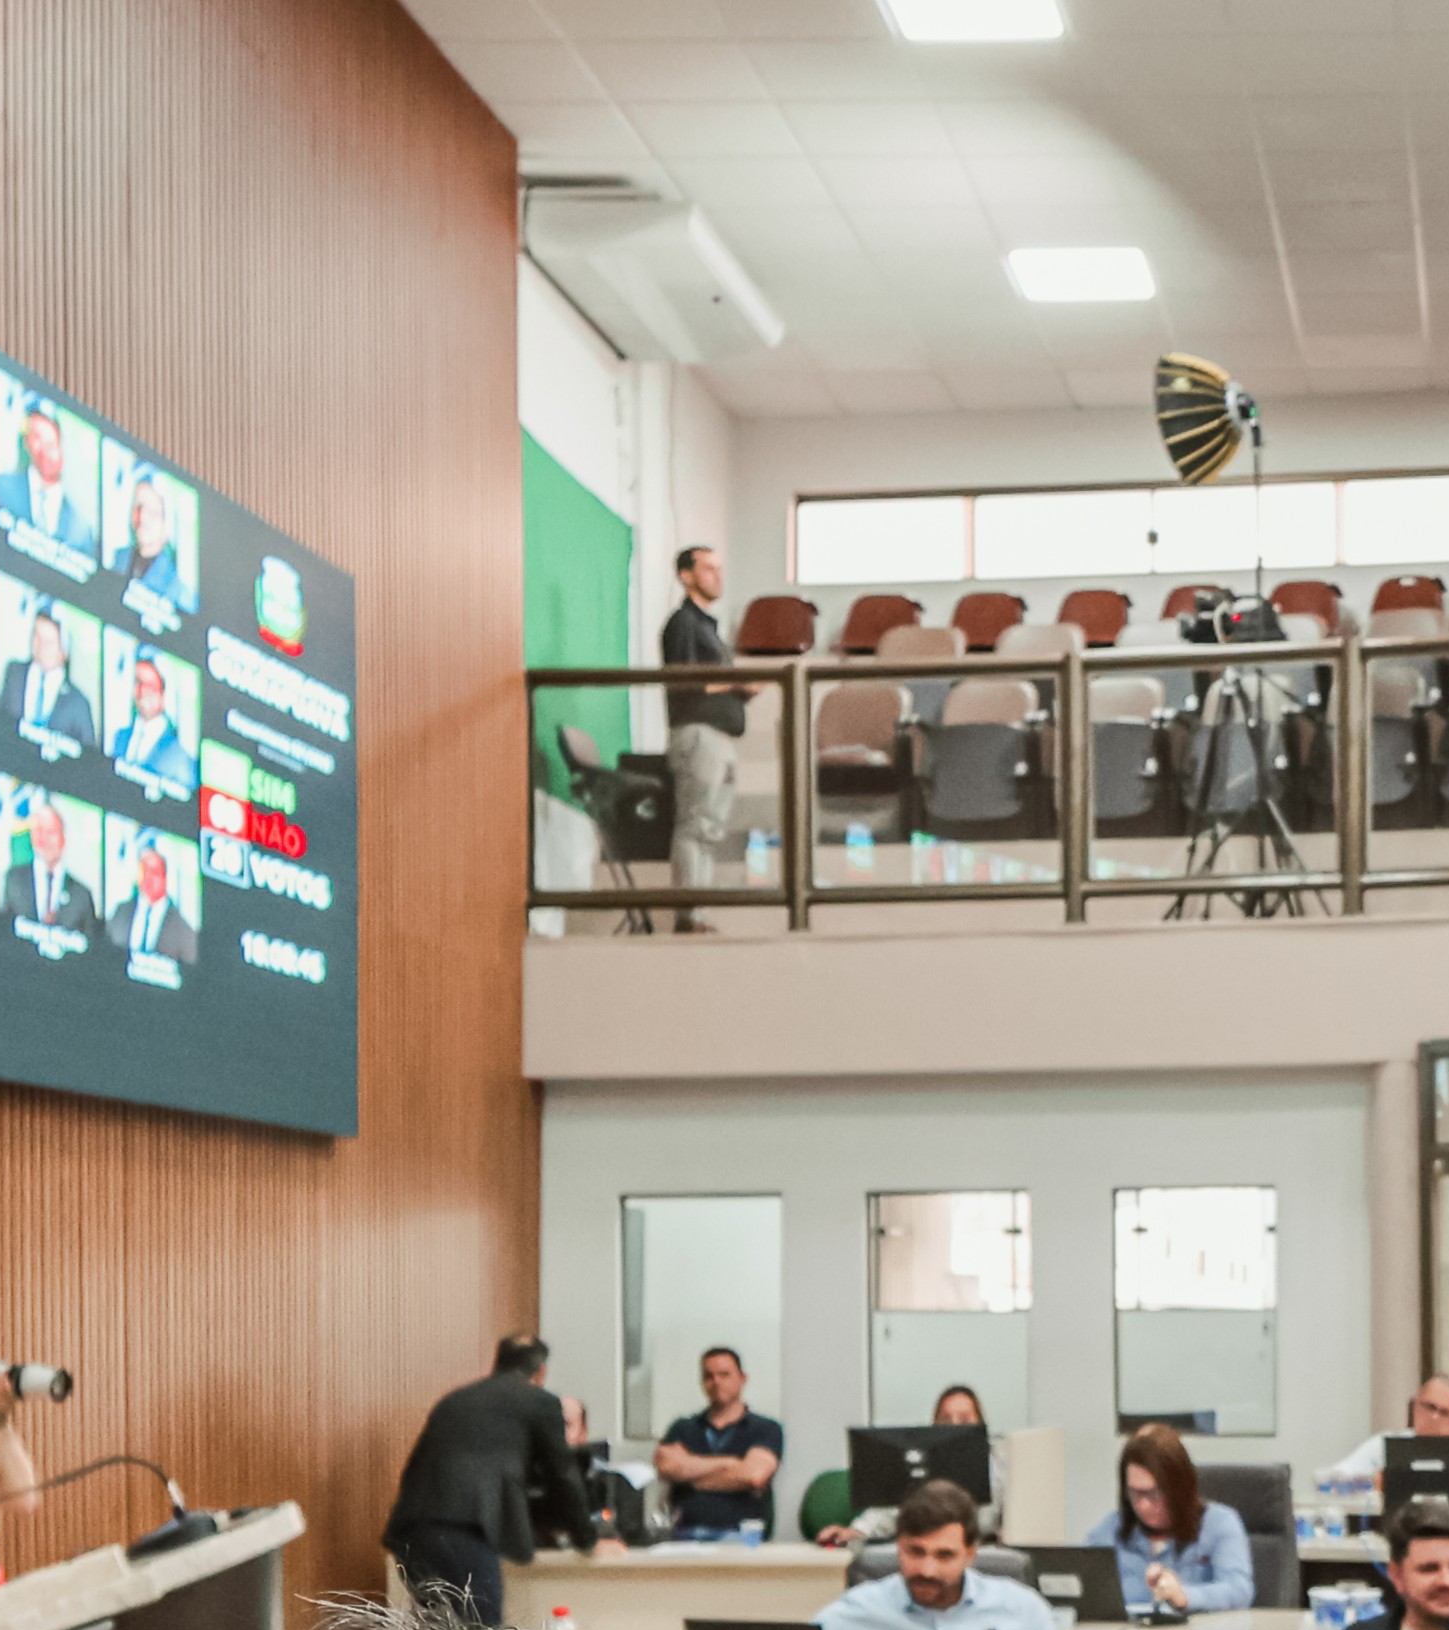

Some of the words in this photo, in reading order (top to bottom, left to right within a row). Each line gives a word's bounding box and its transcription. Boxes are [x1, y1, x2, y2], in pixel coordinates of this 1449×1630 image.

[250, 767, 297, 816] SIM
[251, 810, 308, 859] NÃO
[250, 849, 334, 911] VOTOS
